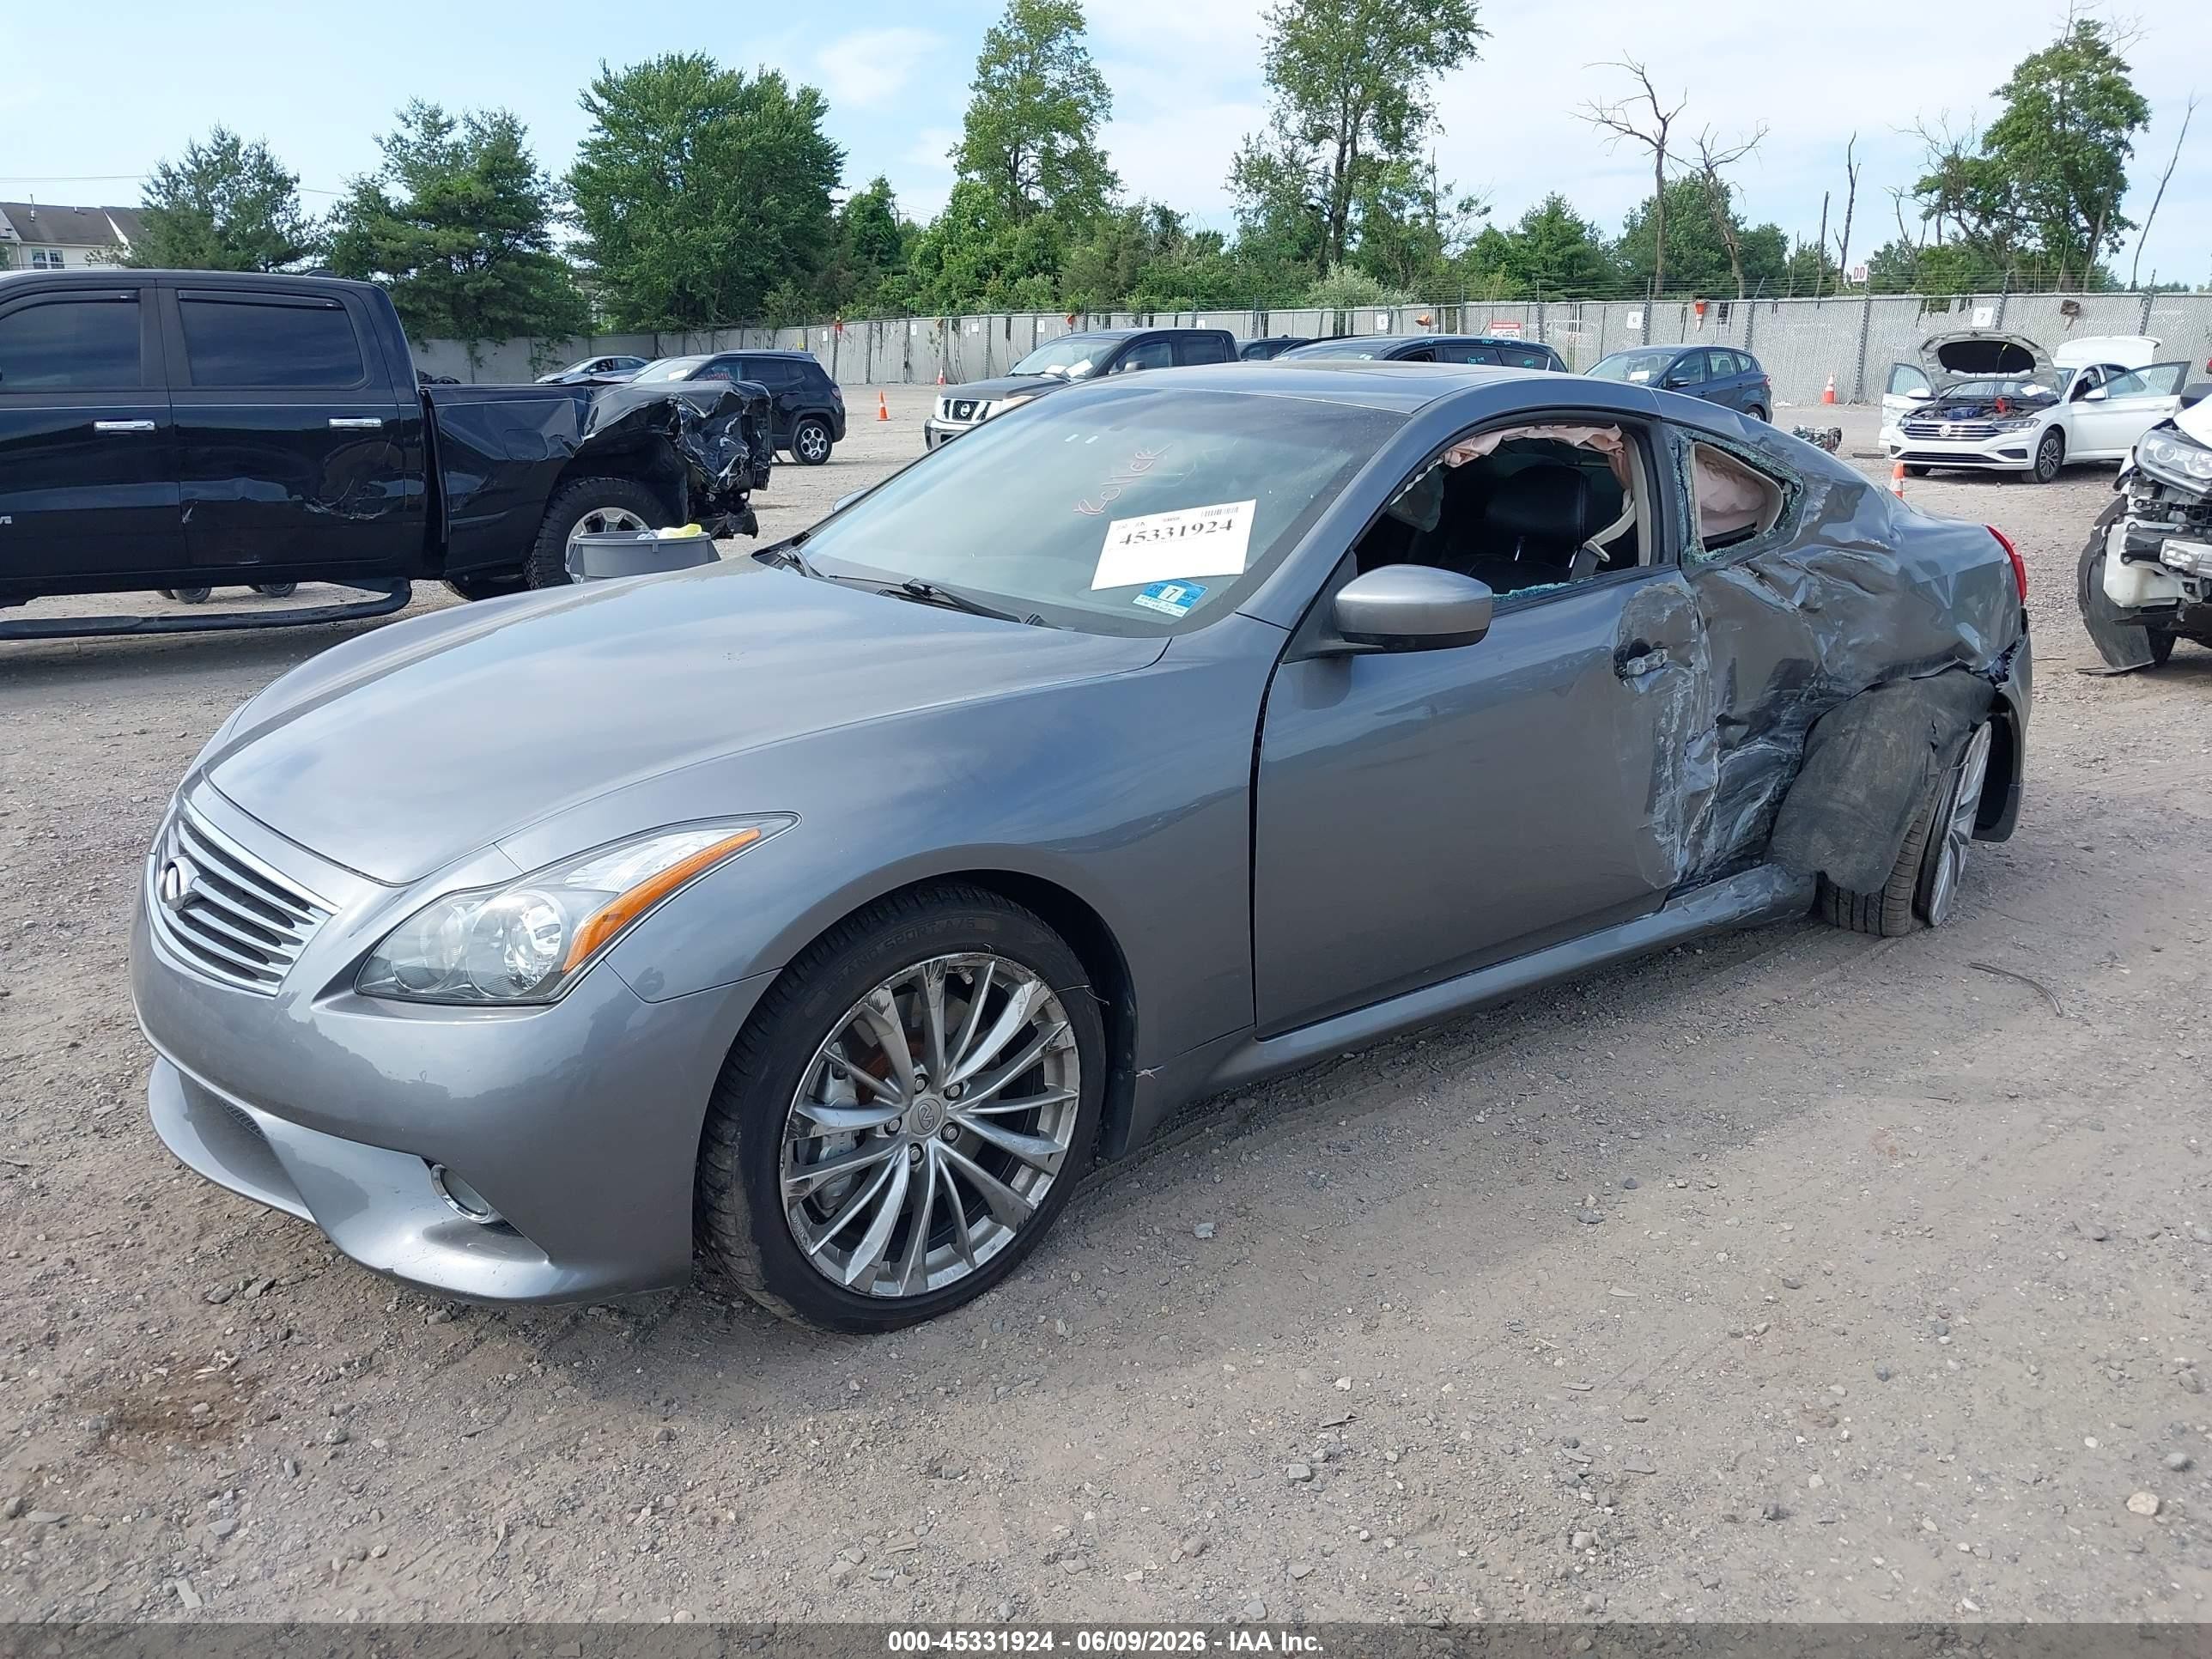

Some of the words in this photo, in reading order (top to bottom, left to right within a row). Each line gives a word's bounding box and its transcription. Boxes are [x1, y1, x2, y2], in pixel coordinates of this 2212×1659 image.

[1853, 266, 1866, 280] DD
[1119, 518, 1233, 544] 45331924
[1164, 587, 1180, 599] 7
[884, 922, 937, 950] SPORT
